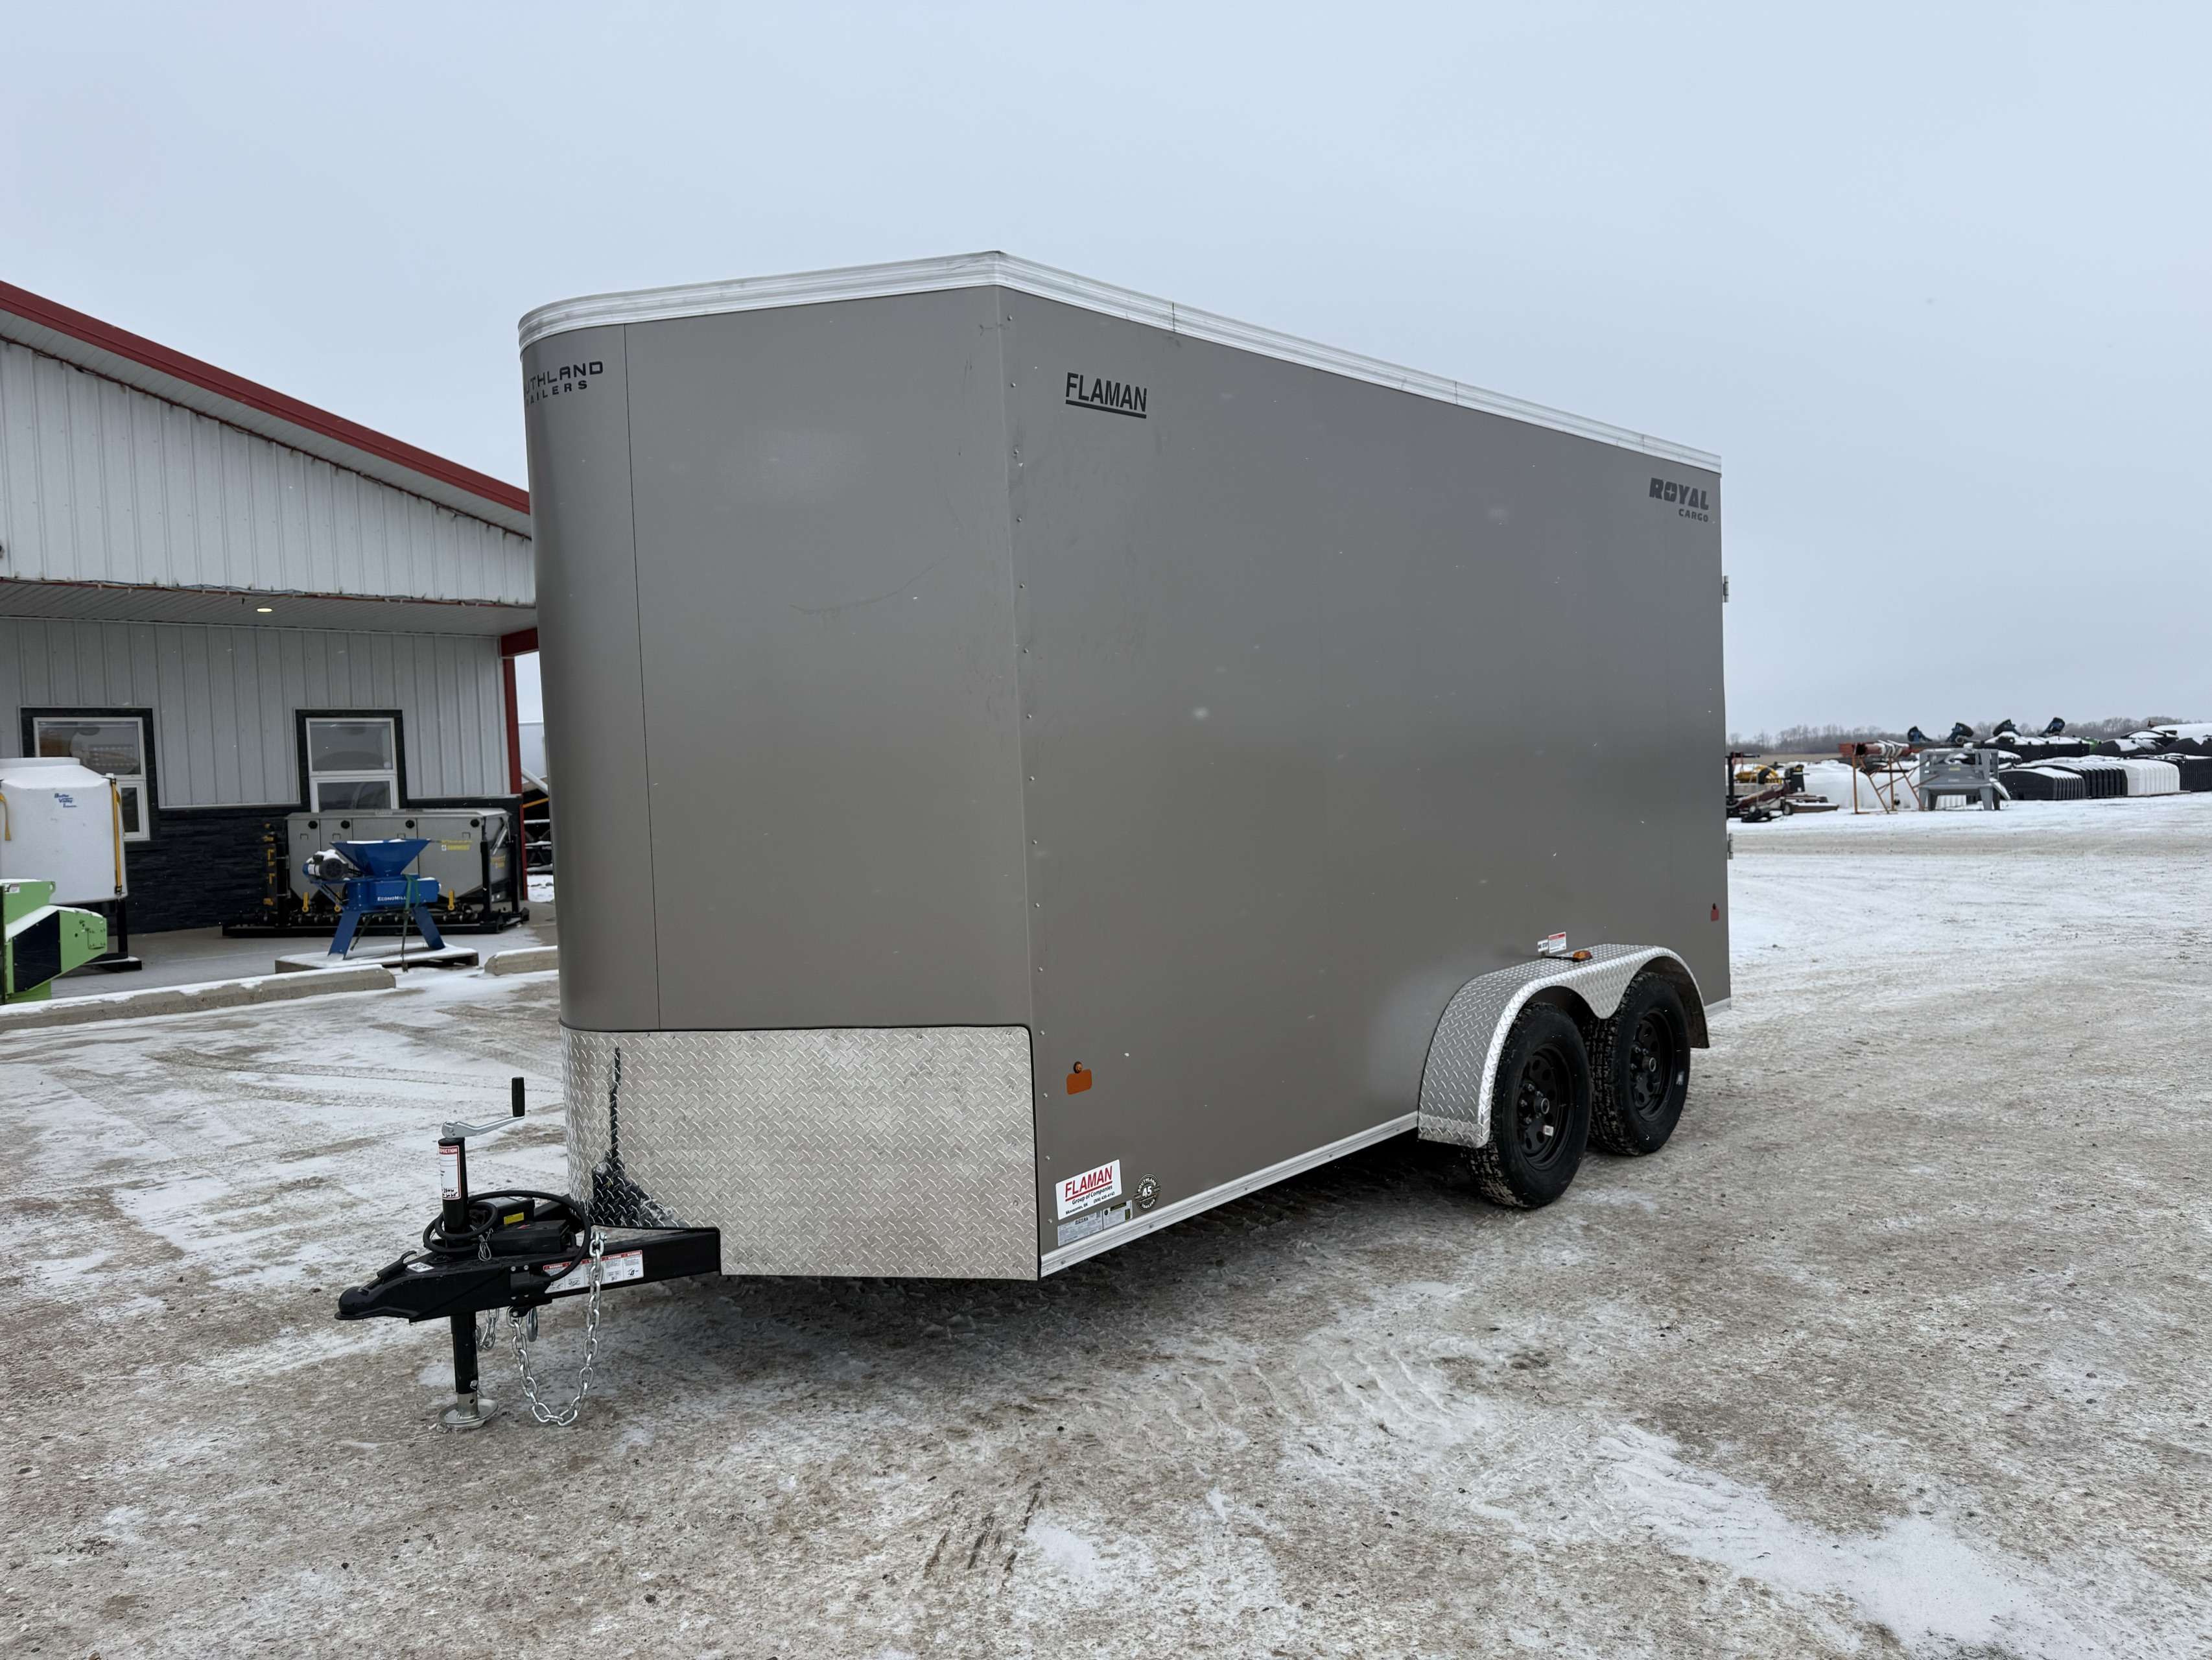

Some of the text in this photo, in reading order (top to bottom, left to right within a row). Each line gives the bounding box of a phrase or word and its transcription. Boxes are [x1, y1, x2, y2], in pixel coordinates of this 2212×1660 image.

[1066, 372, 1147, 412] FLAMAN
[1649, 477, 1709, 510] ROYAL
[1678, 508, 1709, 523] CARGO
[1065, 1166, 1112, 1198] FLAMAN
[1090, 1185, 1112, 1198] Companies
[1142, 1185, 1152, 1198] 45
